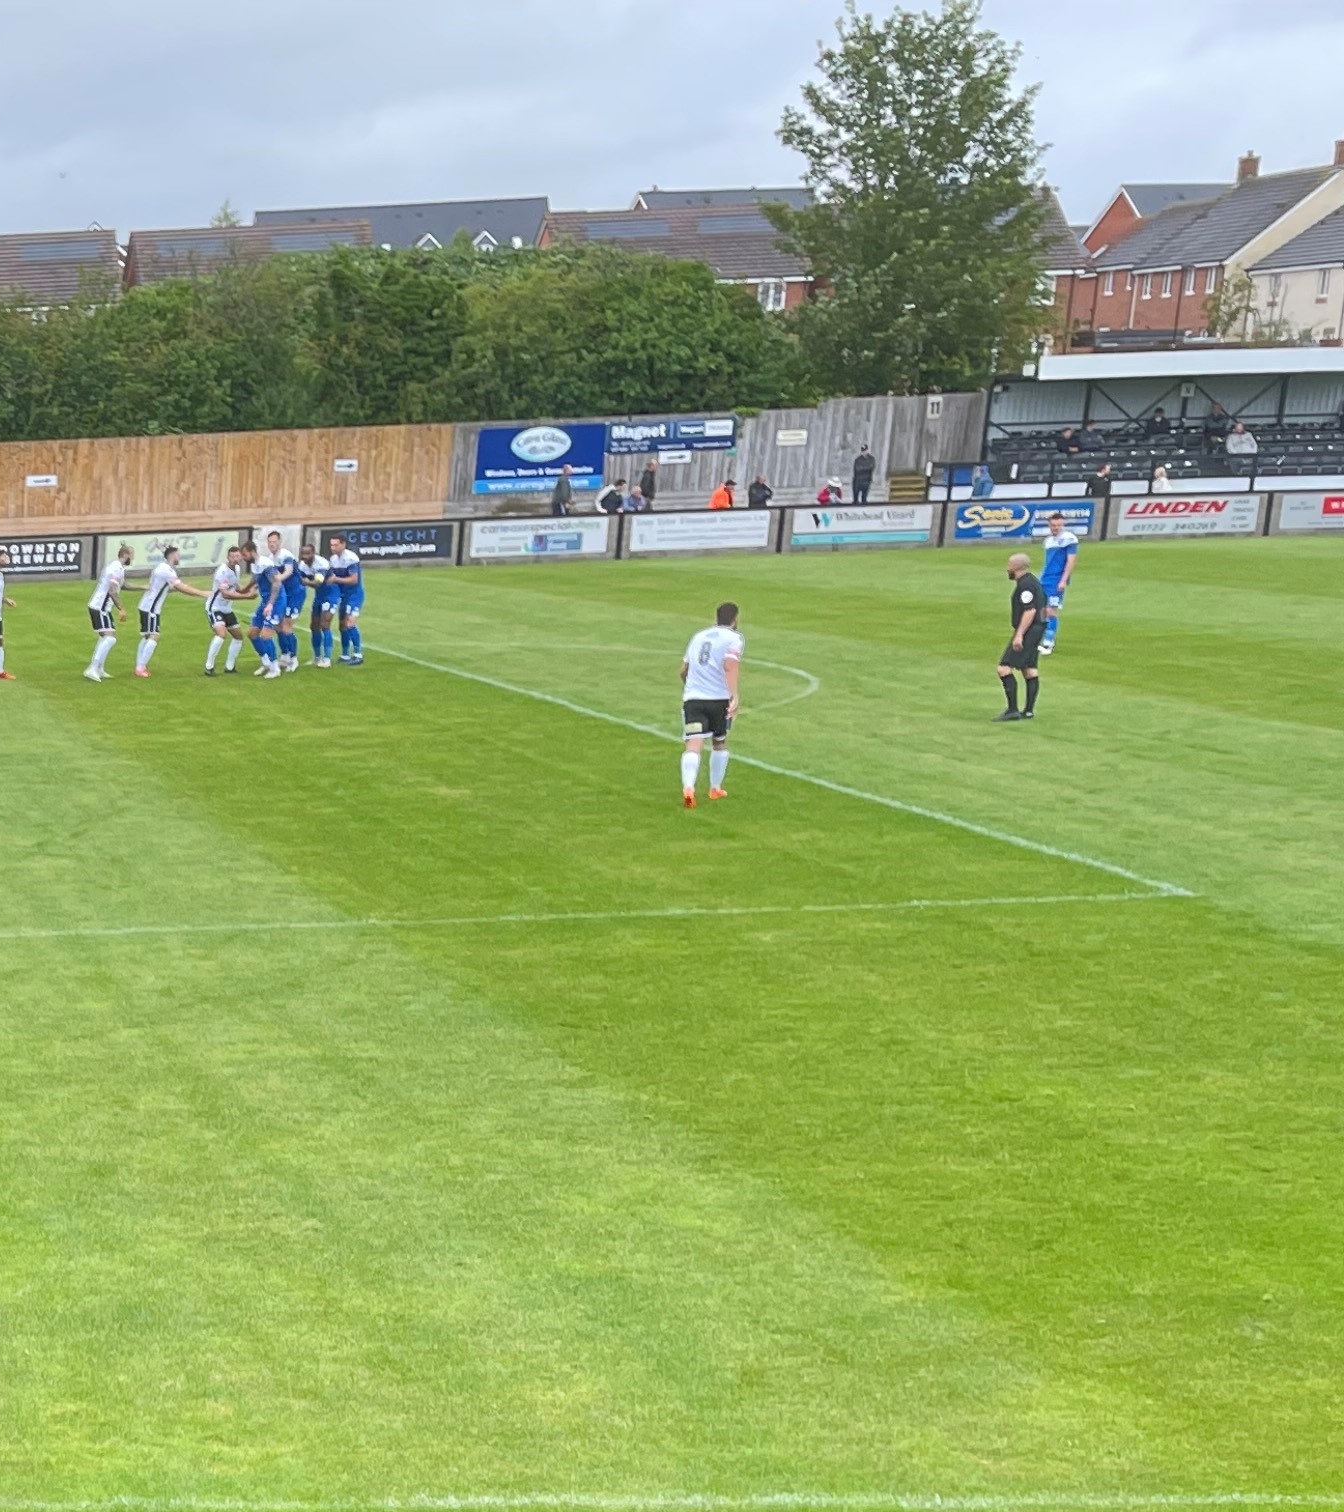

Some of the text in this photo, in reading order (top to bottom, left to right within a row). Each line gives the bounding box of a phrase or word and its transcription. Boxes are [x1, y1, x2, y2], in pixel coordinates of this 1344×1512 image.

[611, 423, 666, 441] Magnet
[1127, 499, 1229, 515] LINDEN
[348, 529, 438, 543] GEOSIGHT
[8, 553, 76, 565] REWERY
[699, 642, 712, 666] 8
